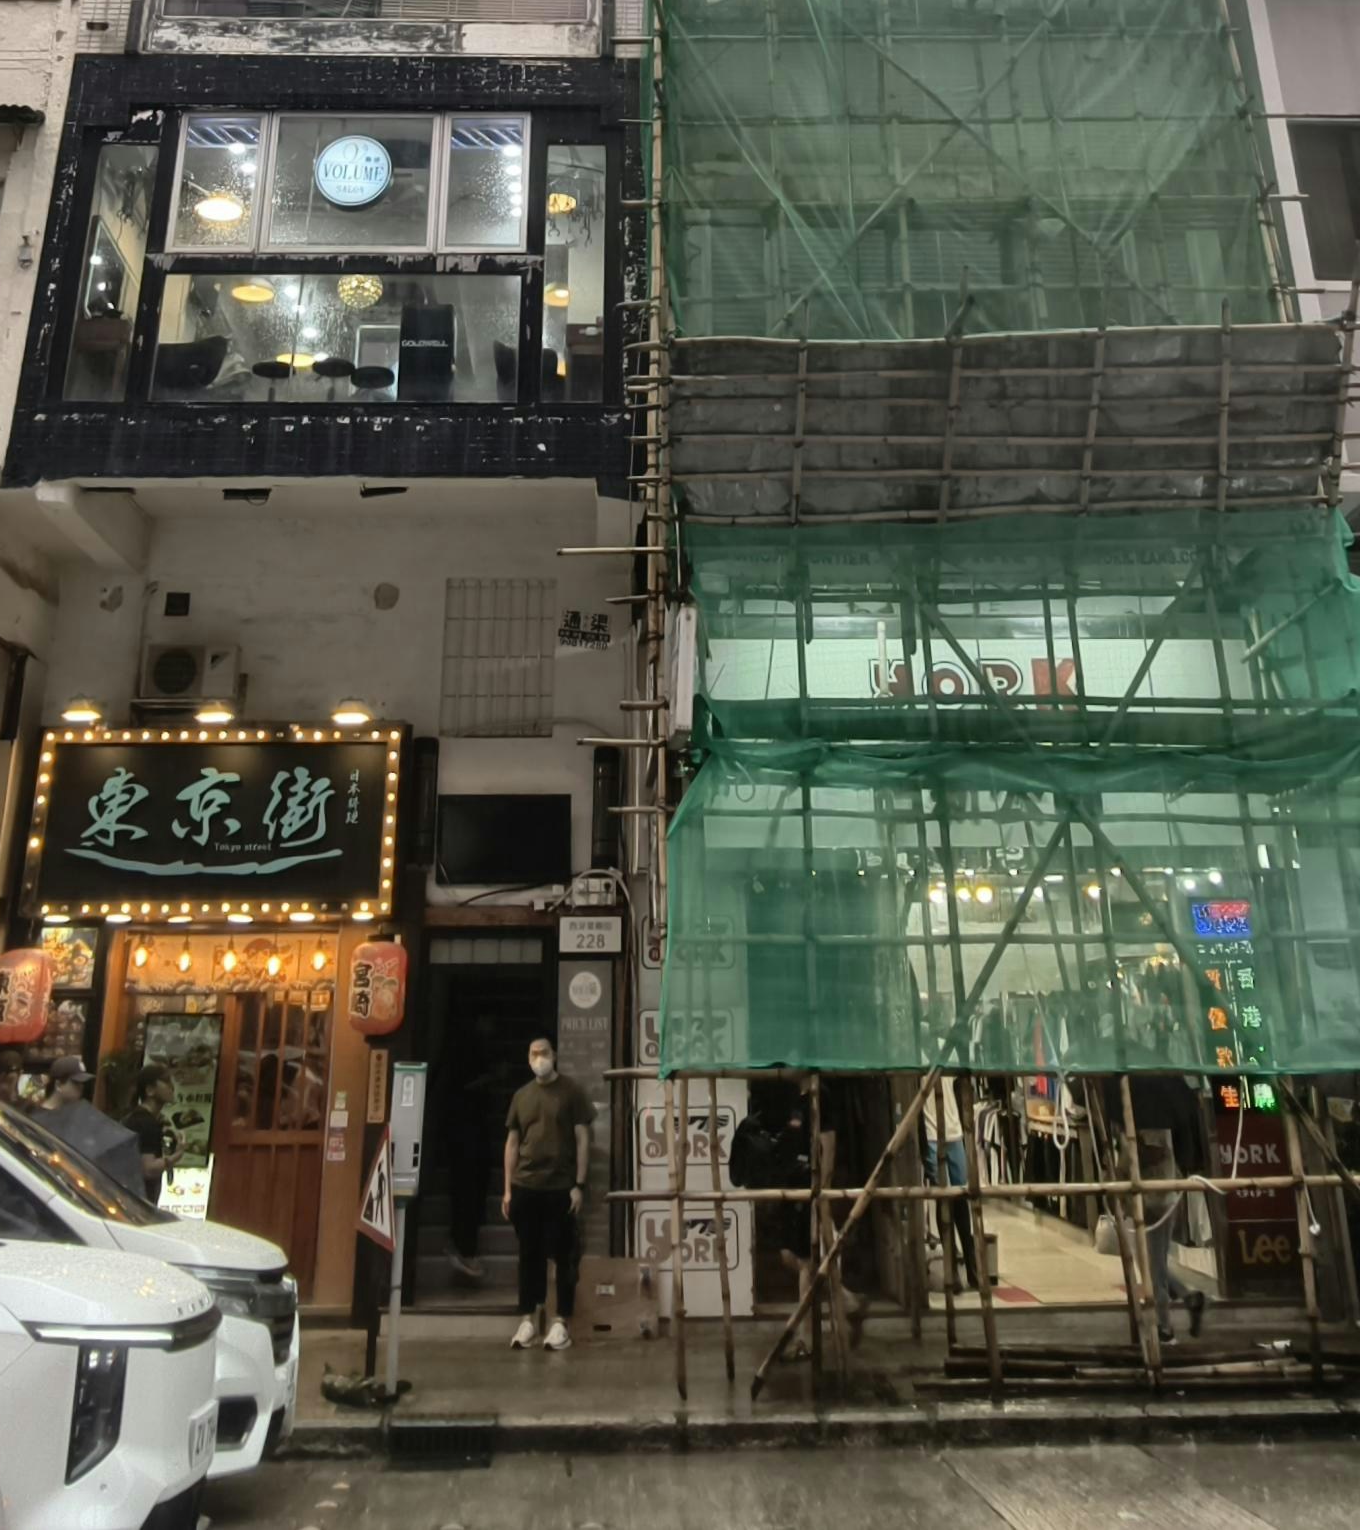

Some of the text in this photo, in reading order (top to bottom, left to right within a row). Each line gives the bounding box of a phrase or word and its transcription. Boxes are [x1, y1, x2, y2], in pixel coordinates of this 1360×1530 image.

[323, 163, 385, 182] VOLUME
[79, 766, 336, 849] 東京街
[214, 842, 242, 853] Tokyo
[576, 933, 606, 949] 228
[1238, 1229, 1291, 1265] Lee
